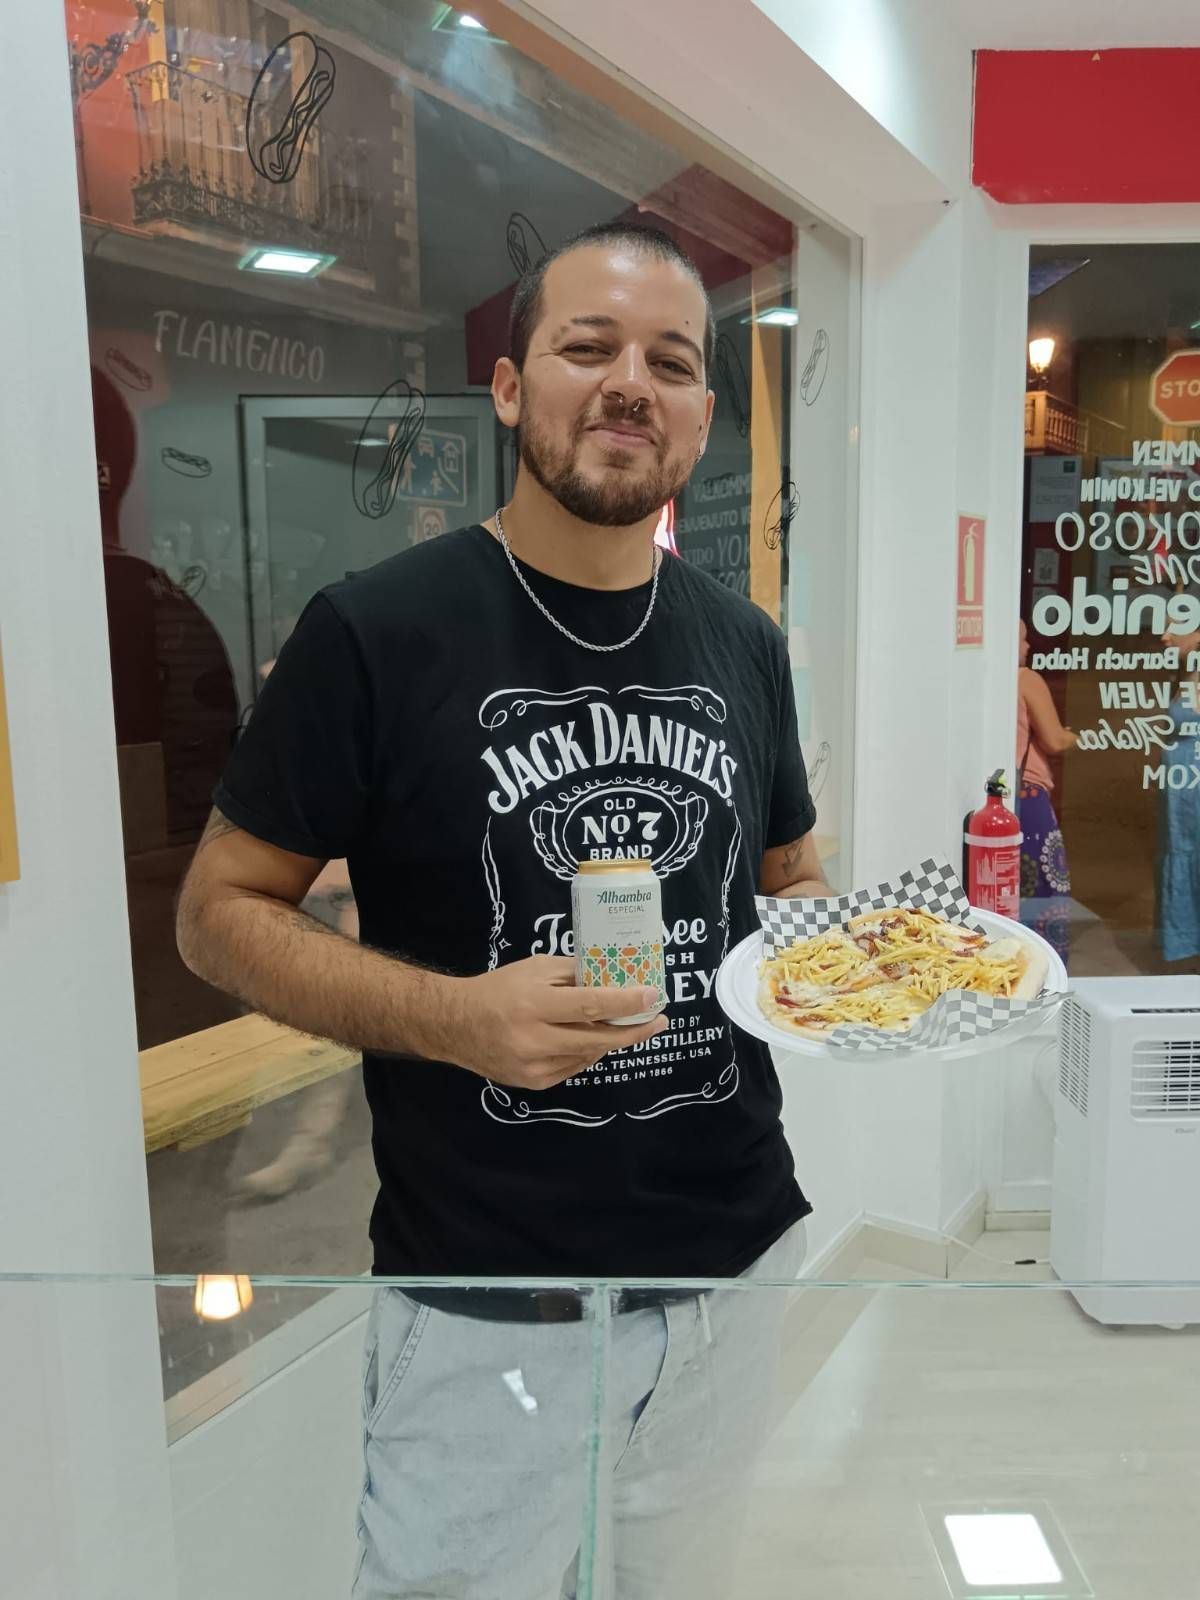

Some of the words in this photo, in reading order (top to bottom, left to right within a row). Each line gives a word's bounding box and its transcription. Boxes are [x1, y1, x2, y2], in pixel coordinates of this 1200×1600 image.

[153, 310, 325, 382] FLAMENCO
[1160, 379, 1200, 399] STO
[480, 721, 592, 814] JACK
[587, 702, 738, 799] DANIEL'S
[603, 797, 636, 811] OLD
[637, 811, 662, 841] 7
[589, 844, 653, 861] BRAND
[596, 889, 652, 904] Alhambra
[608, 904, 645, 914] ESPECIAL
[689, 1015, 701, 1028] BY
[633, 1026, 724, 1052] DISTILLERY
[689, 1046, 712, 1058] USA
[593, 1075, 601, 1085] &
[605, 1073, 632, 1084] REG.
[634, 1071, 646, 1080] IN
[650, 1066, 673, 1078] 1866
